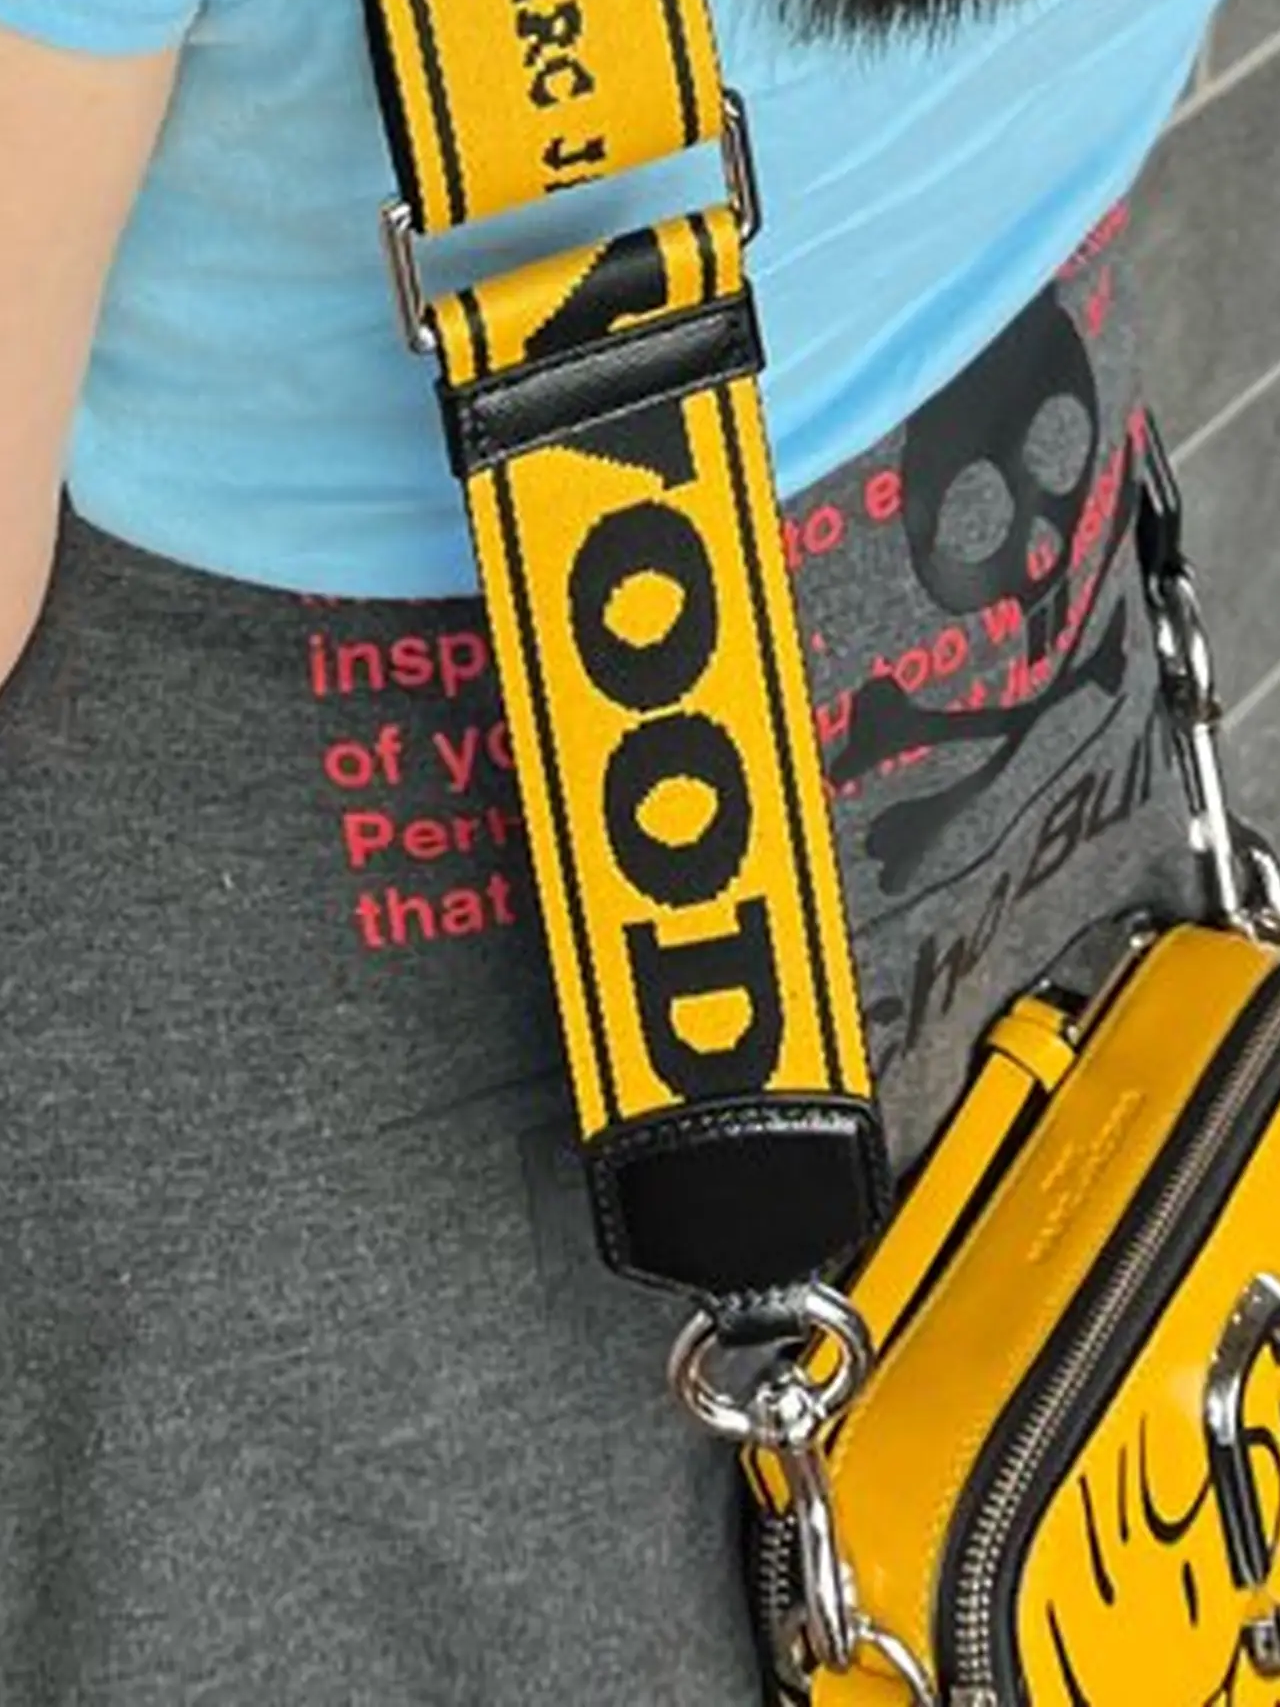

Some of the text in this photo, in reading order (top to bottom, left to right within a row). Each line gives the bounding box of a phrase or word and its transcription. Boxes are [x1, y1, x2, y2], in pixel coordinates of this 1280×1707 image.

[540, 134, 608, 193] J
[323, 724, 402, 787] of
[355, 873, 516, 948] that
